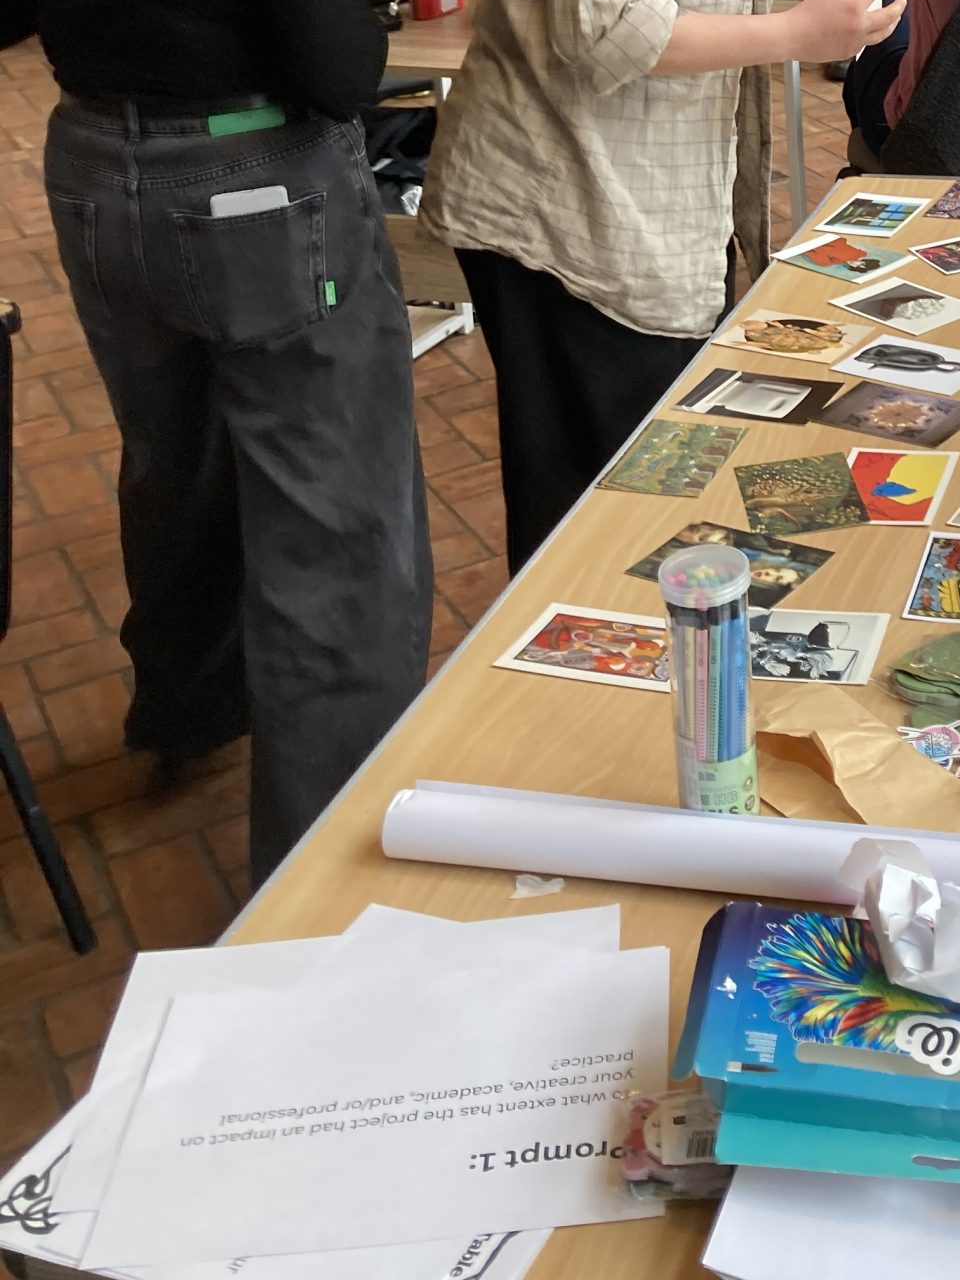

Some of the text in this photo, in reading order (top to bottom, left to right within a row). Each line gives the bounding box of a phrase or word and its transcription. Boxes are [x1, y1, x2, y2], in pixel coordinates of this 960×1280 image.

[551, 1049, 634, 1071] practice?
[219, 1067, 635, 1127] your creative, academic, and/or professional
[562, 1092, 606, 1106] what
[461, 1104, 491, 1117] has
[497, 1098, 556, 1113] extent
[350, 1109, 418, 1130] project
[424, 1108, 454, 1121] the
[281, 1125, 304, 1137] an
[309, 1121, 344, 1136] had
[180, 1136, 205, 1148] on
[209, 1129, 276, 1146] impact
[469, 1152, 496, 1172] 1:
